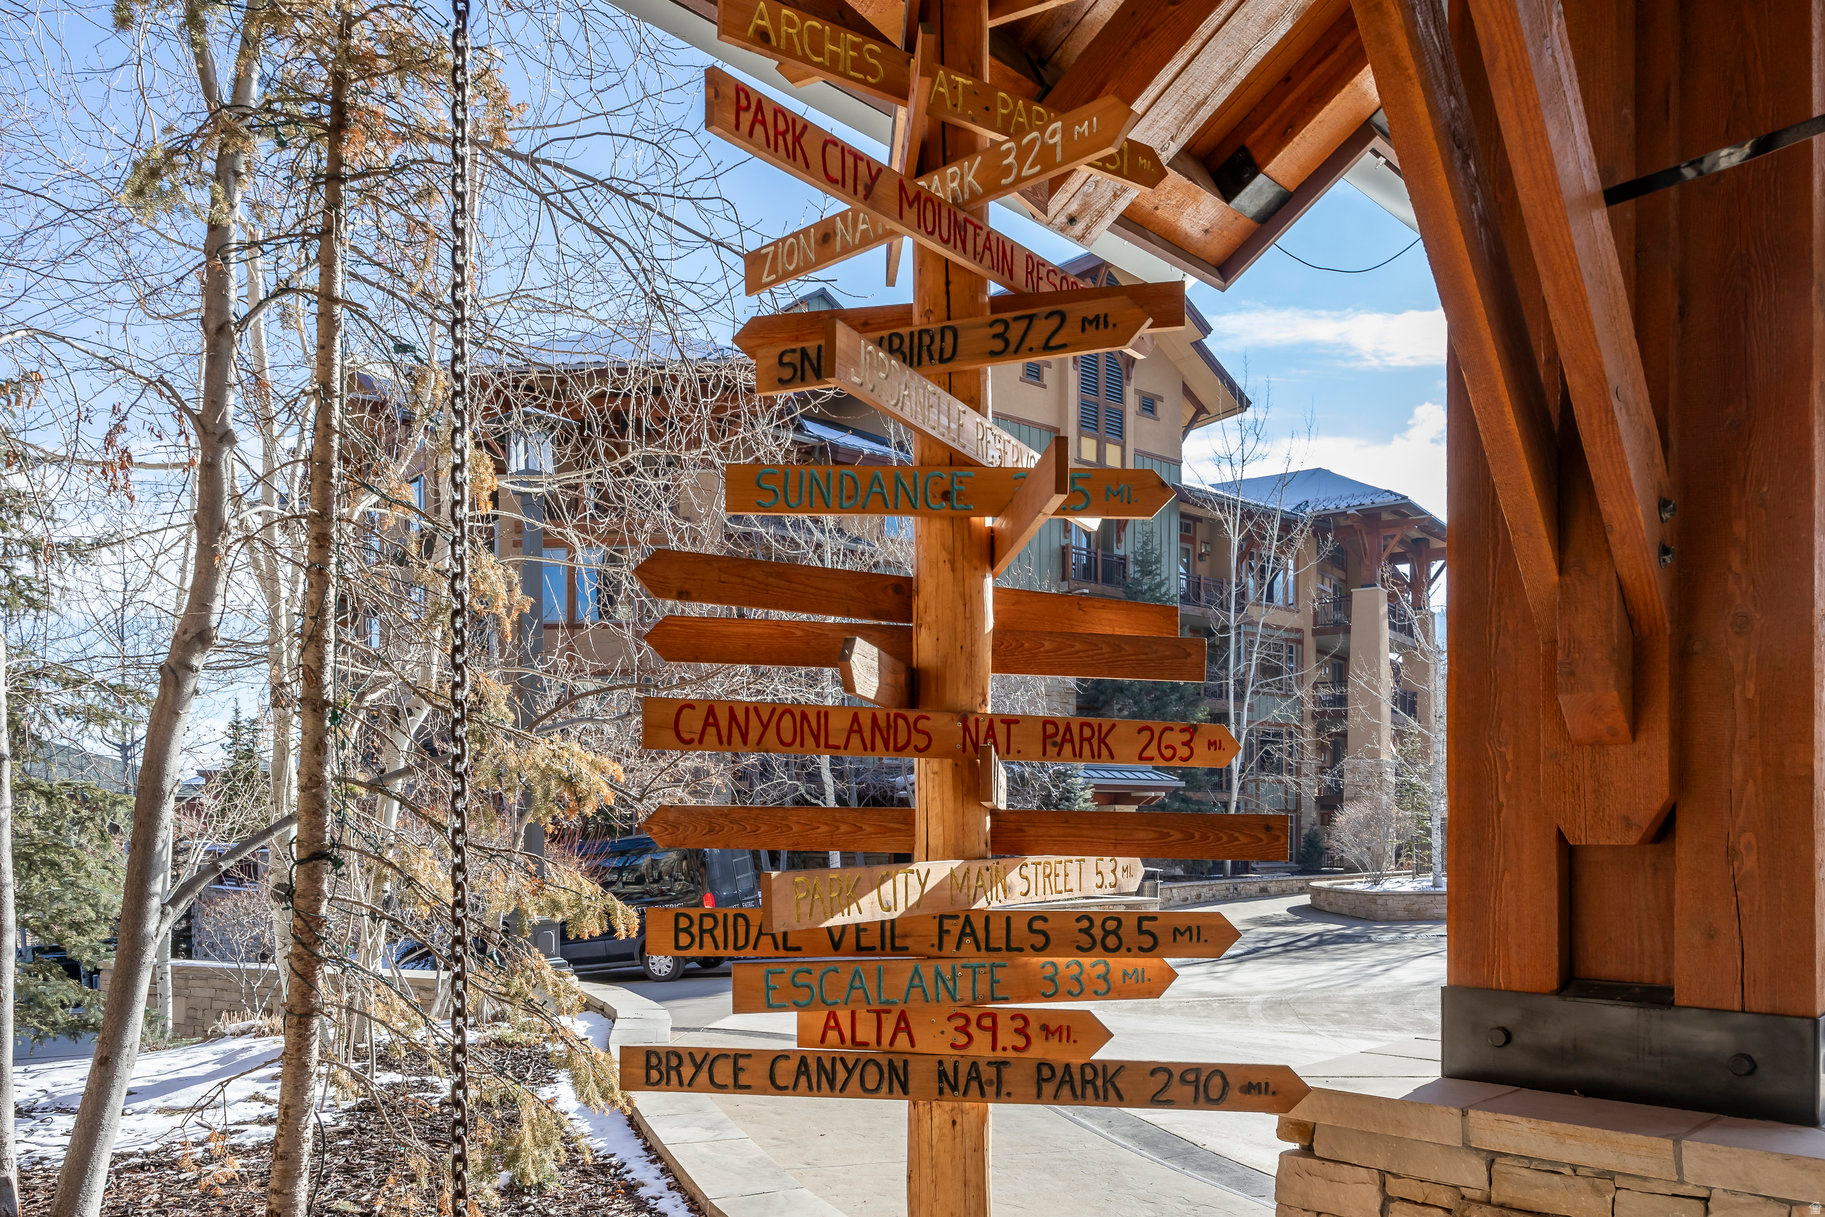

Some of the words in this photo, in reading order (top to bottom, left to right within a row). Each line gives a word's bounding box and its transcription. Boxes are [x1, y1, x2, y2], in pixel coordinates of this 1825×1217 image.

[747, 1, 884, 84] ARCHES
[996, 91, 1055, 134] PAR
[1138, 156, 1155, 172] MI.
[735, 82, 810, 170] PARK
[822, 137, 883, 201] CITY
[898, 178, 1014, 282] MOUNTAIN
[760, 228, 816, 284] ZION
[1000, 121, 1063, 186] 329
[1074, 116, 1097, 141] MI
[777, 325, 958, 386] SNBIRD
[989, 310, 1069, 358] 37.2
[1081, 312, 1117, 333] MI.
[755, 468, 975, 510] SUNDANCE
[1105, 483, 1139, 505] MI.
[673, 703, 933, 754] CANYONLANDS
[961, 717, 1022, 755] NAT.
[1041, 719, 1117, 761] PARK
[1137, 724, 1195, 762] 263
[1207, 738, 1226, 752] MI.
[793, 873, 862, 923] PARK
[877, 867, 931, 914] CITY
[949, 861, 1008, 907] MAIN
[1019, 857, 1086, 898] STREET
[1095, 856, 1119, 889] 5.3
[1121, 864, 1134, 880] MI.
[825, 917, 910, 952] VEIL
[937, 913, 1051, 953] FALLS
[1075, 914, 1160, 954] 38.5
[1172, 924, 1209, 944] MI.
[764, 961, 1011, 1009] ESCALANTE
[1039, 958, 1112, 998] 333
[1121, 966, 1152, 985] MI.
[820, 1009, 917, 1049] ALTA
[946, 1011, 1033, 1053] 39.3
[1044, 1023, 1078, 1044] MI.
[644, 1049, 753, 1089] BRYCE
[768, 1054, 910, 1096] CANYON
[937, 1059, 1012, 1099] NAT.
[1036, 1061, 1126, 1102] PARK
[1149, 1066, 1230, 1106] 290
[1246, 1080, 1277, 1096] MI.
